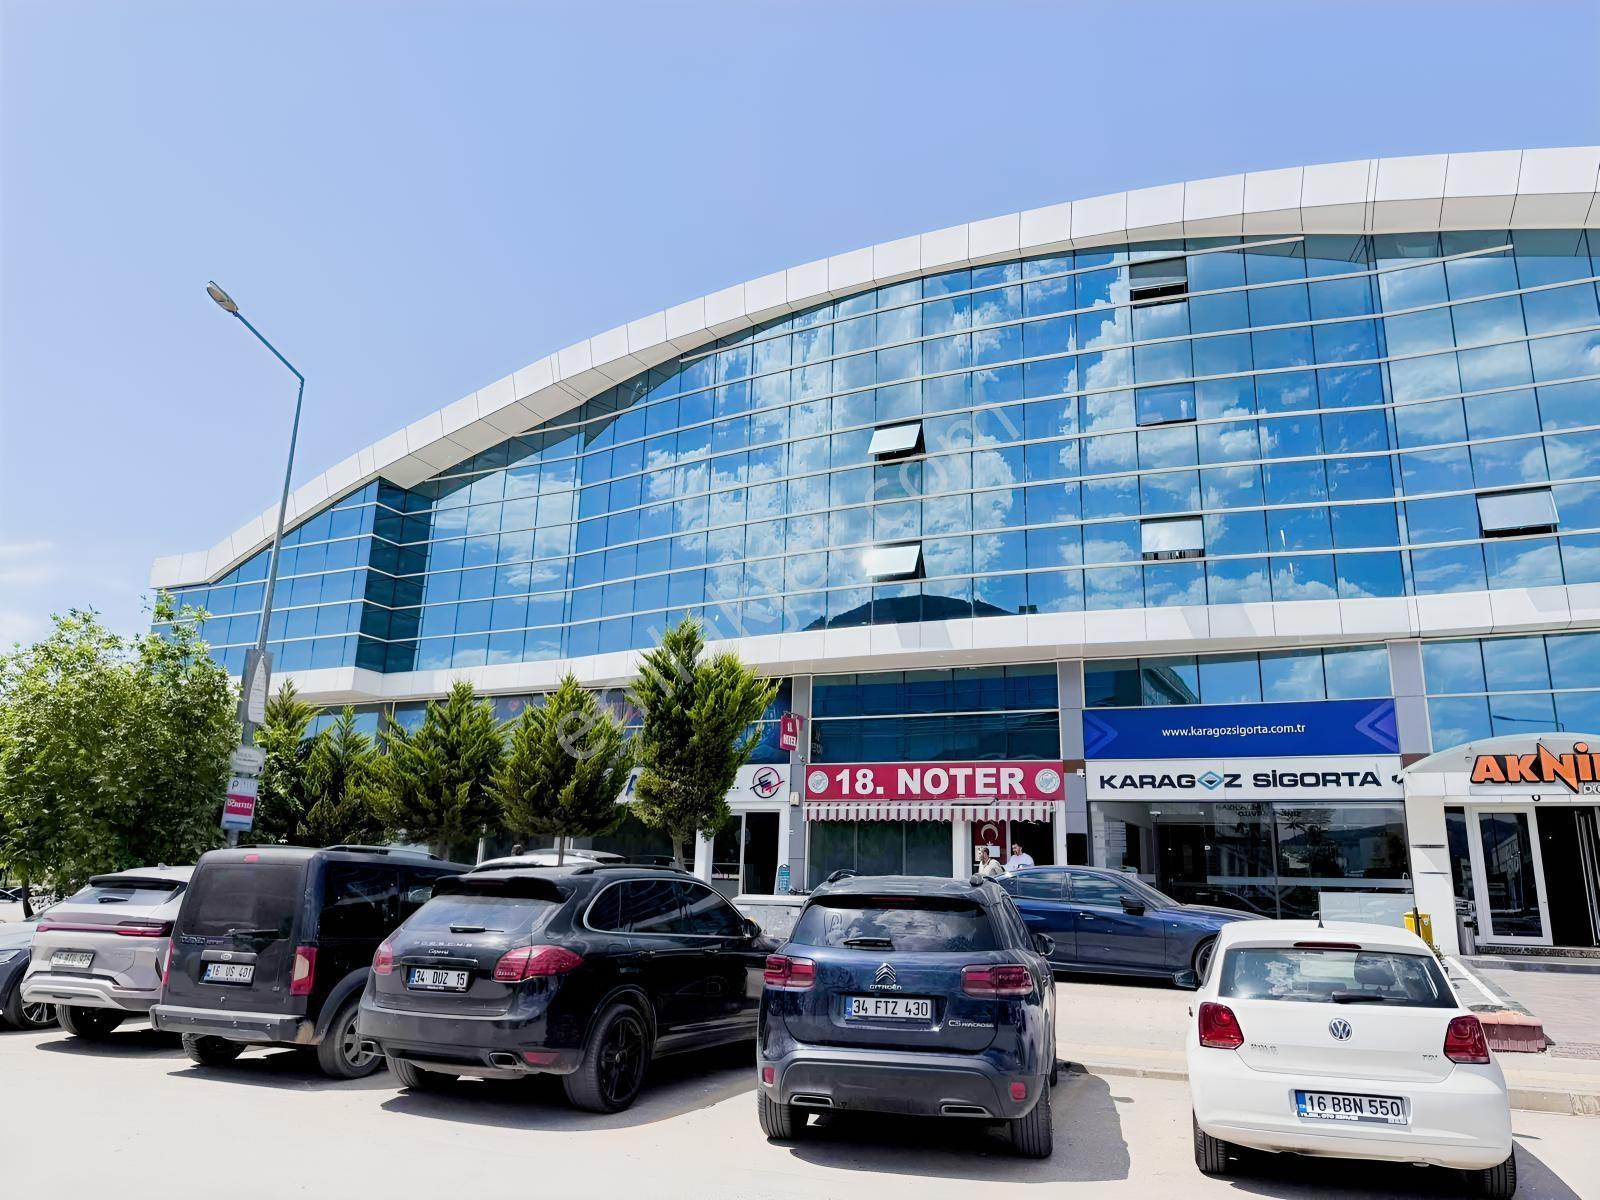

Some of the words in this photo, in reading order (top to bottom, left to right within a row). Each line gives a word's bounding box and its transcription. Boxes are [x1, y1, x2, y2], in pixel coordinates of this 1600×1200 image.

[1162, 723, 1306, 738] www.karagozsigorta.com.tr
[835, 768, 884, 795] 18.
[897, 768, 1027, 795] NOTER
[1252, 769, 1382, 789] SİGORTA
[212, 964, 220, 976] 16
[238, 967, 252, 978] 401
[415, 970, 425, 983] 34
[432, 971, 449, 985] DUZ
[456, 972, 466, 986] 15
[853, 999, 868, 1014] 34
[875, 1000, 898, 1015] FTZ
[905, 1001, 928, 1016] 430
[1308, 1095, 1327, 1112] 16
[1332, 1096, 1364, 1114] BBN
[1368, 1099, 1401, 1117] 550
